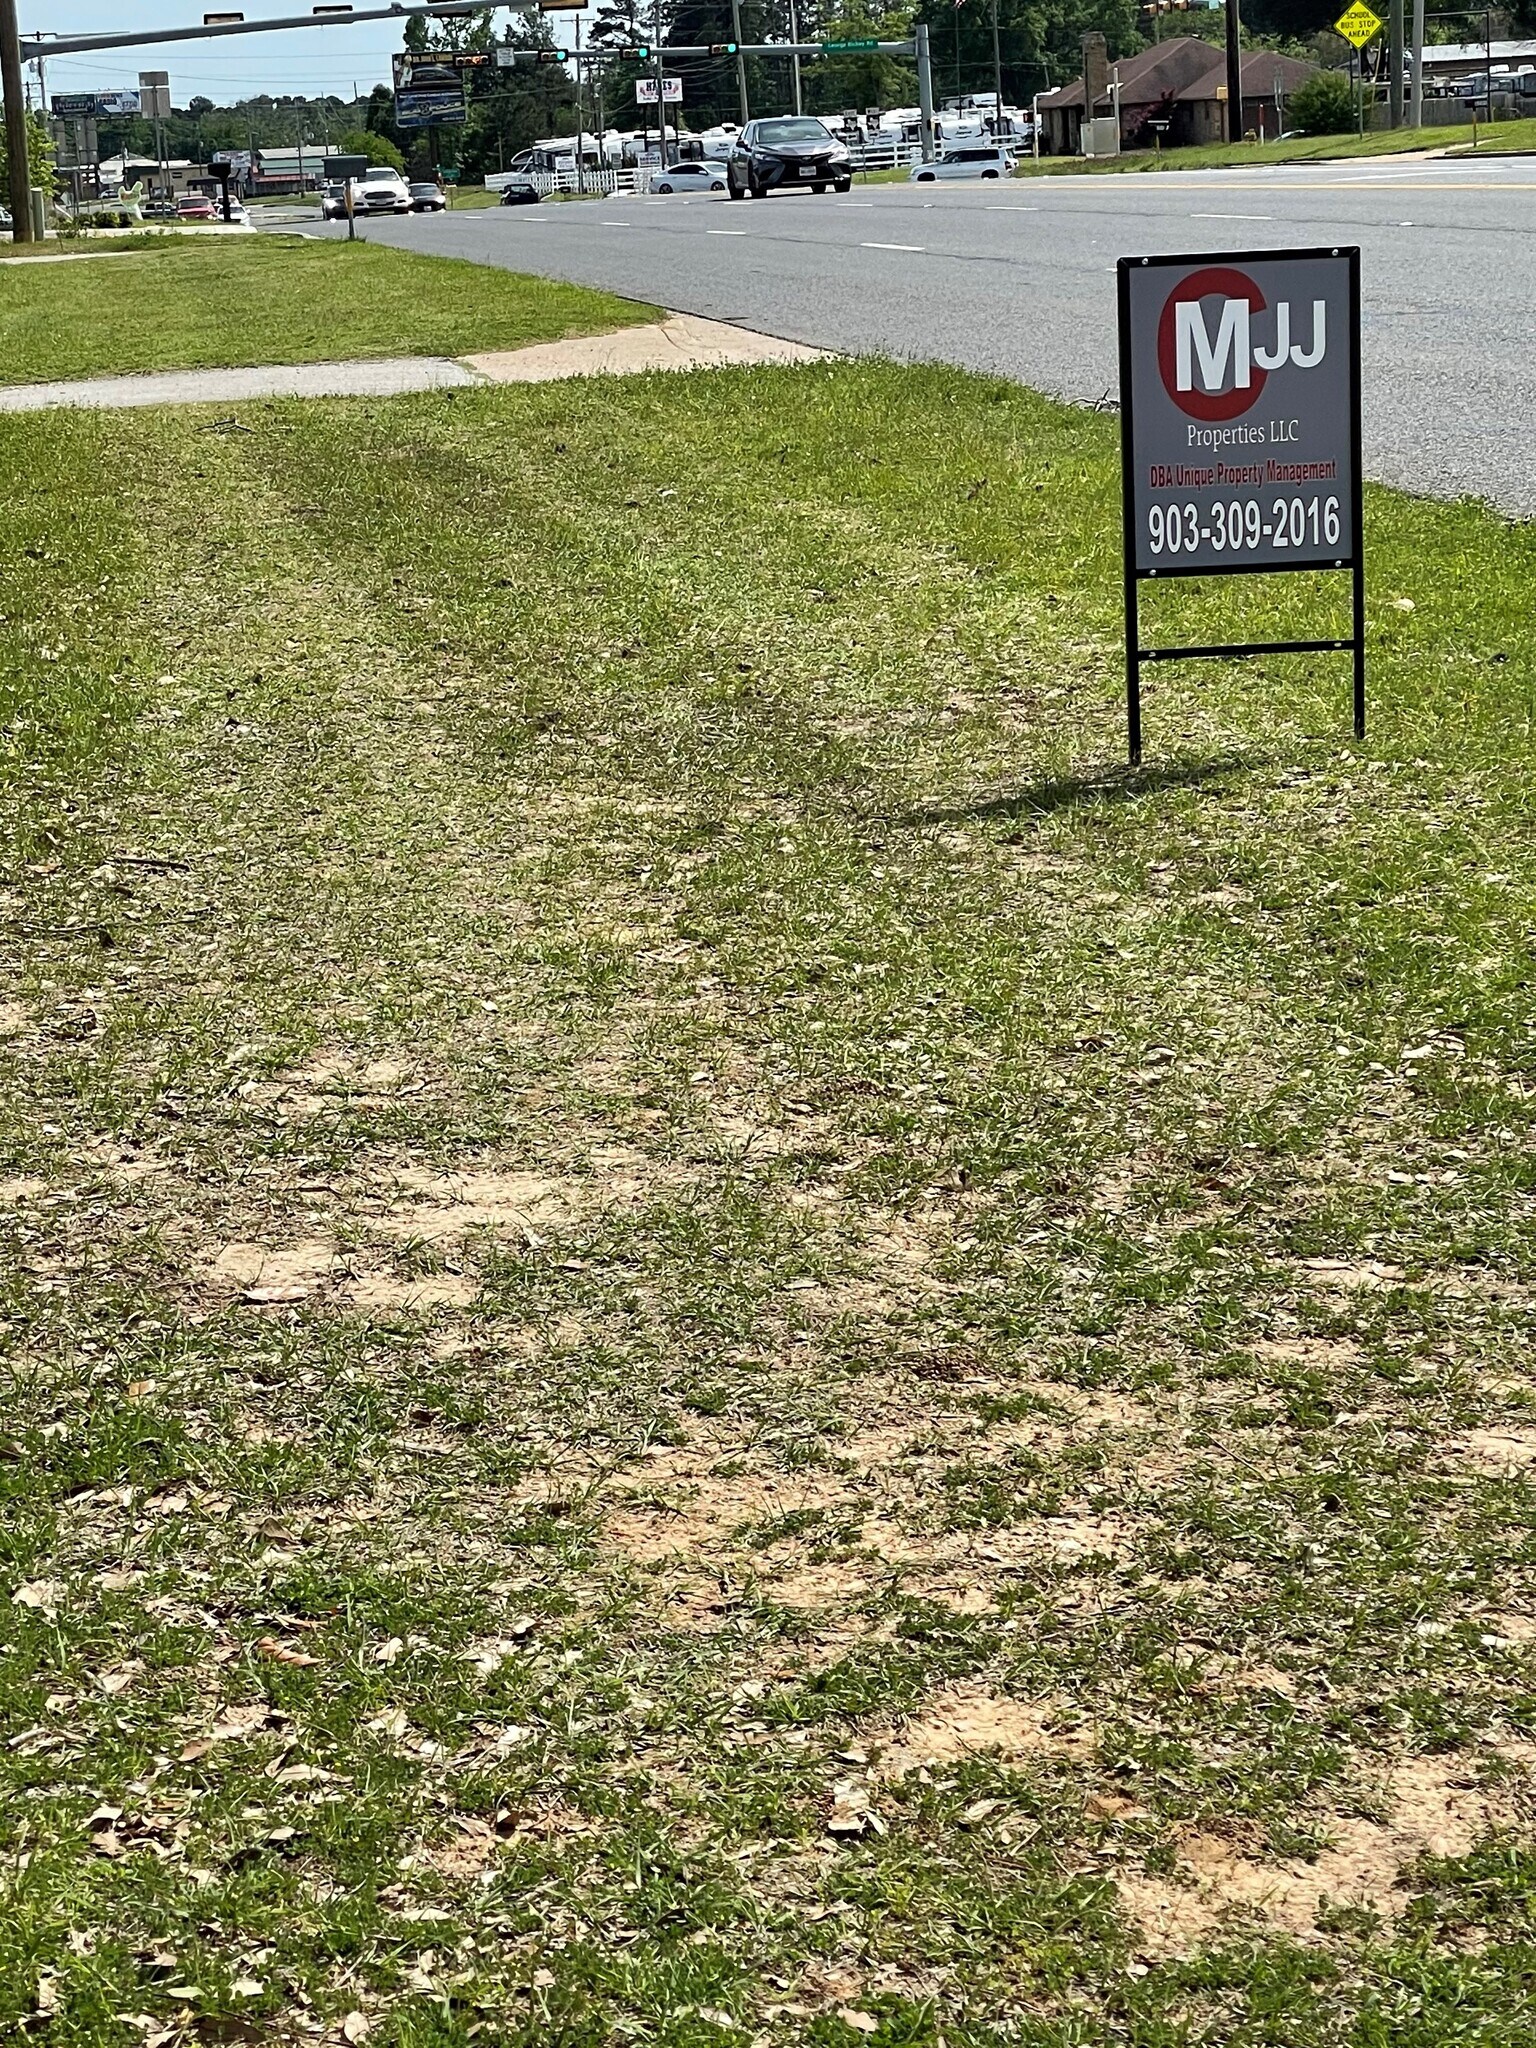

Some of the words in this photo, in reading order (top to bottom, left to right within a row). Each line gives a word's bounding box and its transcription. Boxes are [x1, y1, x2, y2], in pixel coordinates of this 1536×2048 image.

[1359, 20, 1375, 28] STOP
[646, 80, 672, 91] HAES
[1187, 423, 1265, 452] Properties
[1270, 419, 1299, 442] LLC
[1150, 464, 1173, 488] DBA
[1176, 463, 1214, 491] Unique
[1217, 461, 1264, 489] Property
[1266, 457, 1337, 487] Management
[1148, 495, 1341, 555] 903-309-2016
